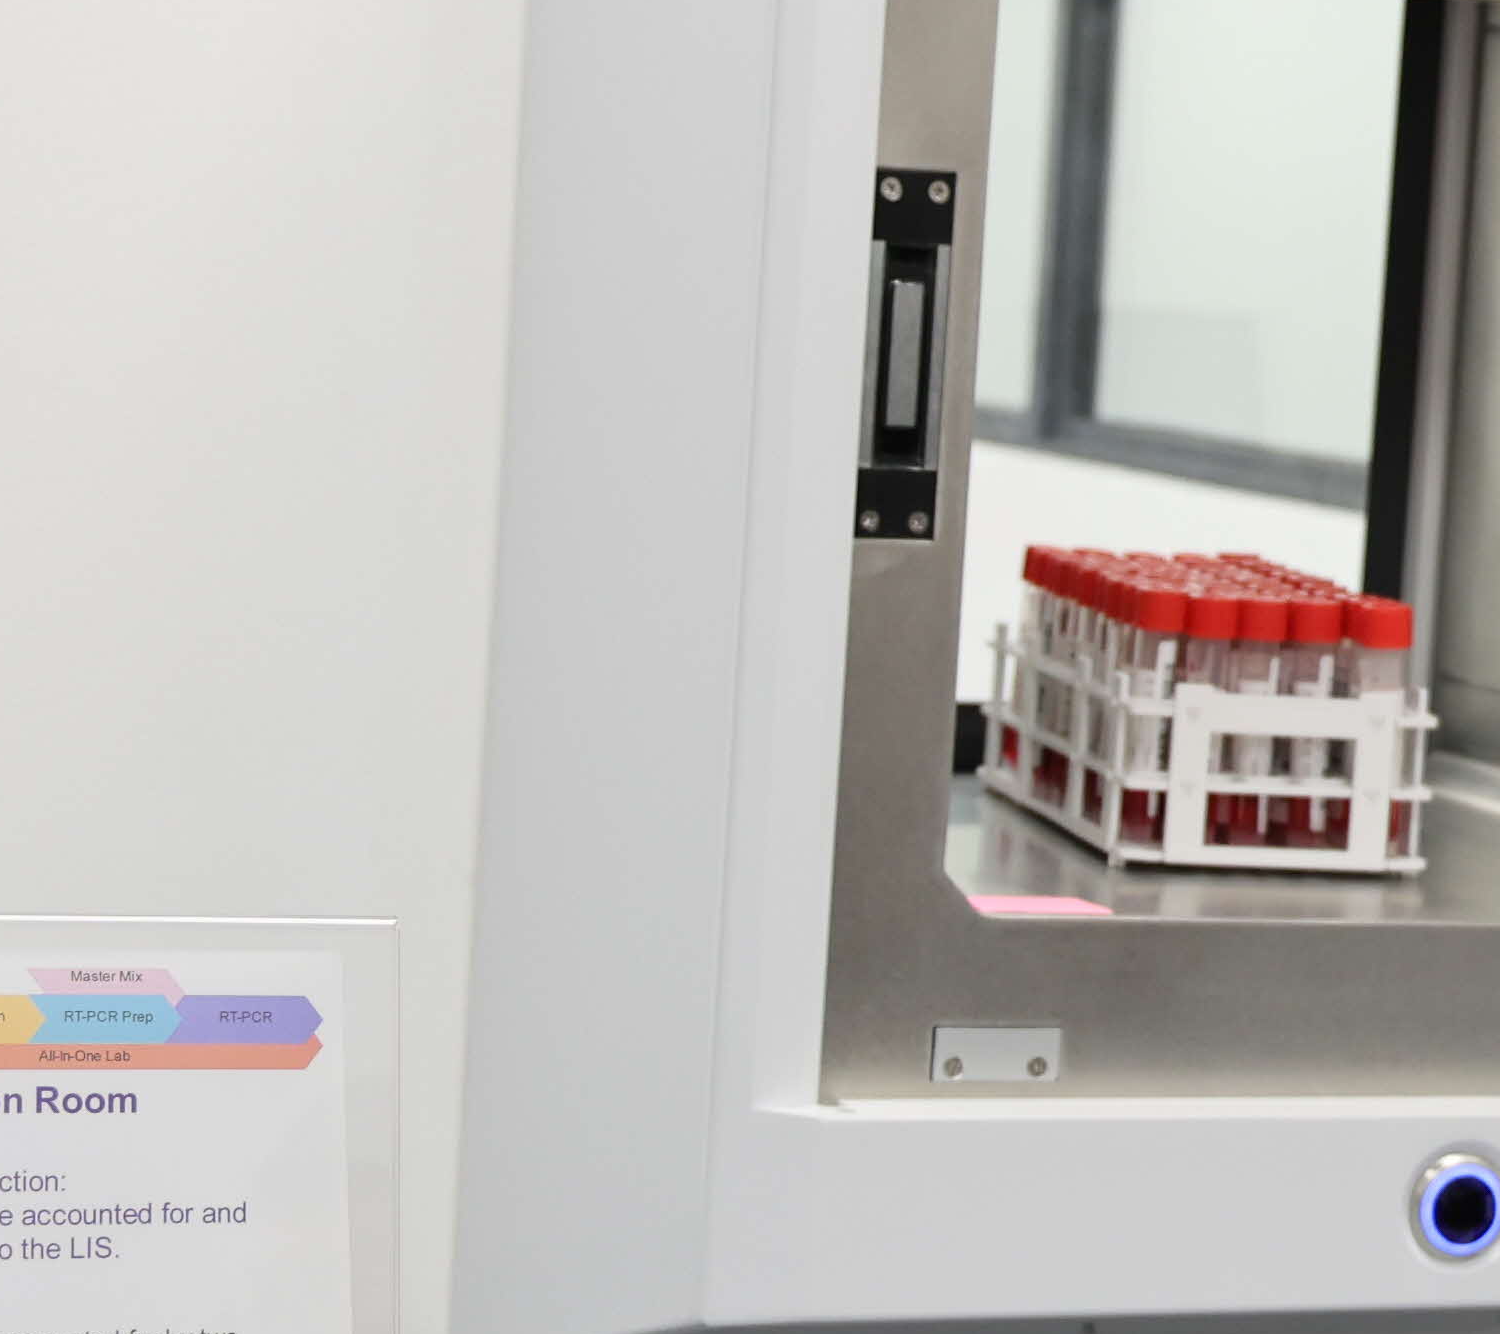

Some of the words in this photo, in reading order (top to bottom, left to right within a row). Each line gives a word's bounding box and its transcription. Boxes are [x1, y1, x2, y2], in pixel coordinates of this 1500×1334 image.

[70, 970, 117, 983] Master
[118, 970, 143, 983] Mix
[63, 1010, 119, 1023] RT-PCR
[121, 1010, 154, 1026] Prep
[219, 1010, 273, 1024] RT-PCR
[105, 1050, 131, 1063] Lab
[35, 1085, 138, 1114] Room
[21, 1202, 153, 1227] accounted
[160, 1201, 194, 1225] for
[202, 1200, 247, 1224] and
[20, 1237, 62, 1260] the
[70, 1235, 120, 1260] LIS.
